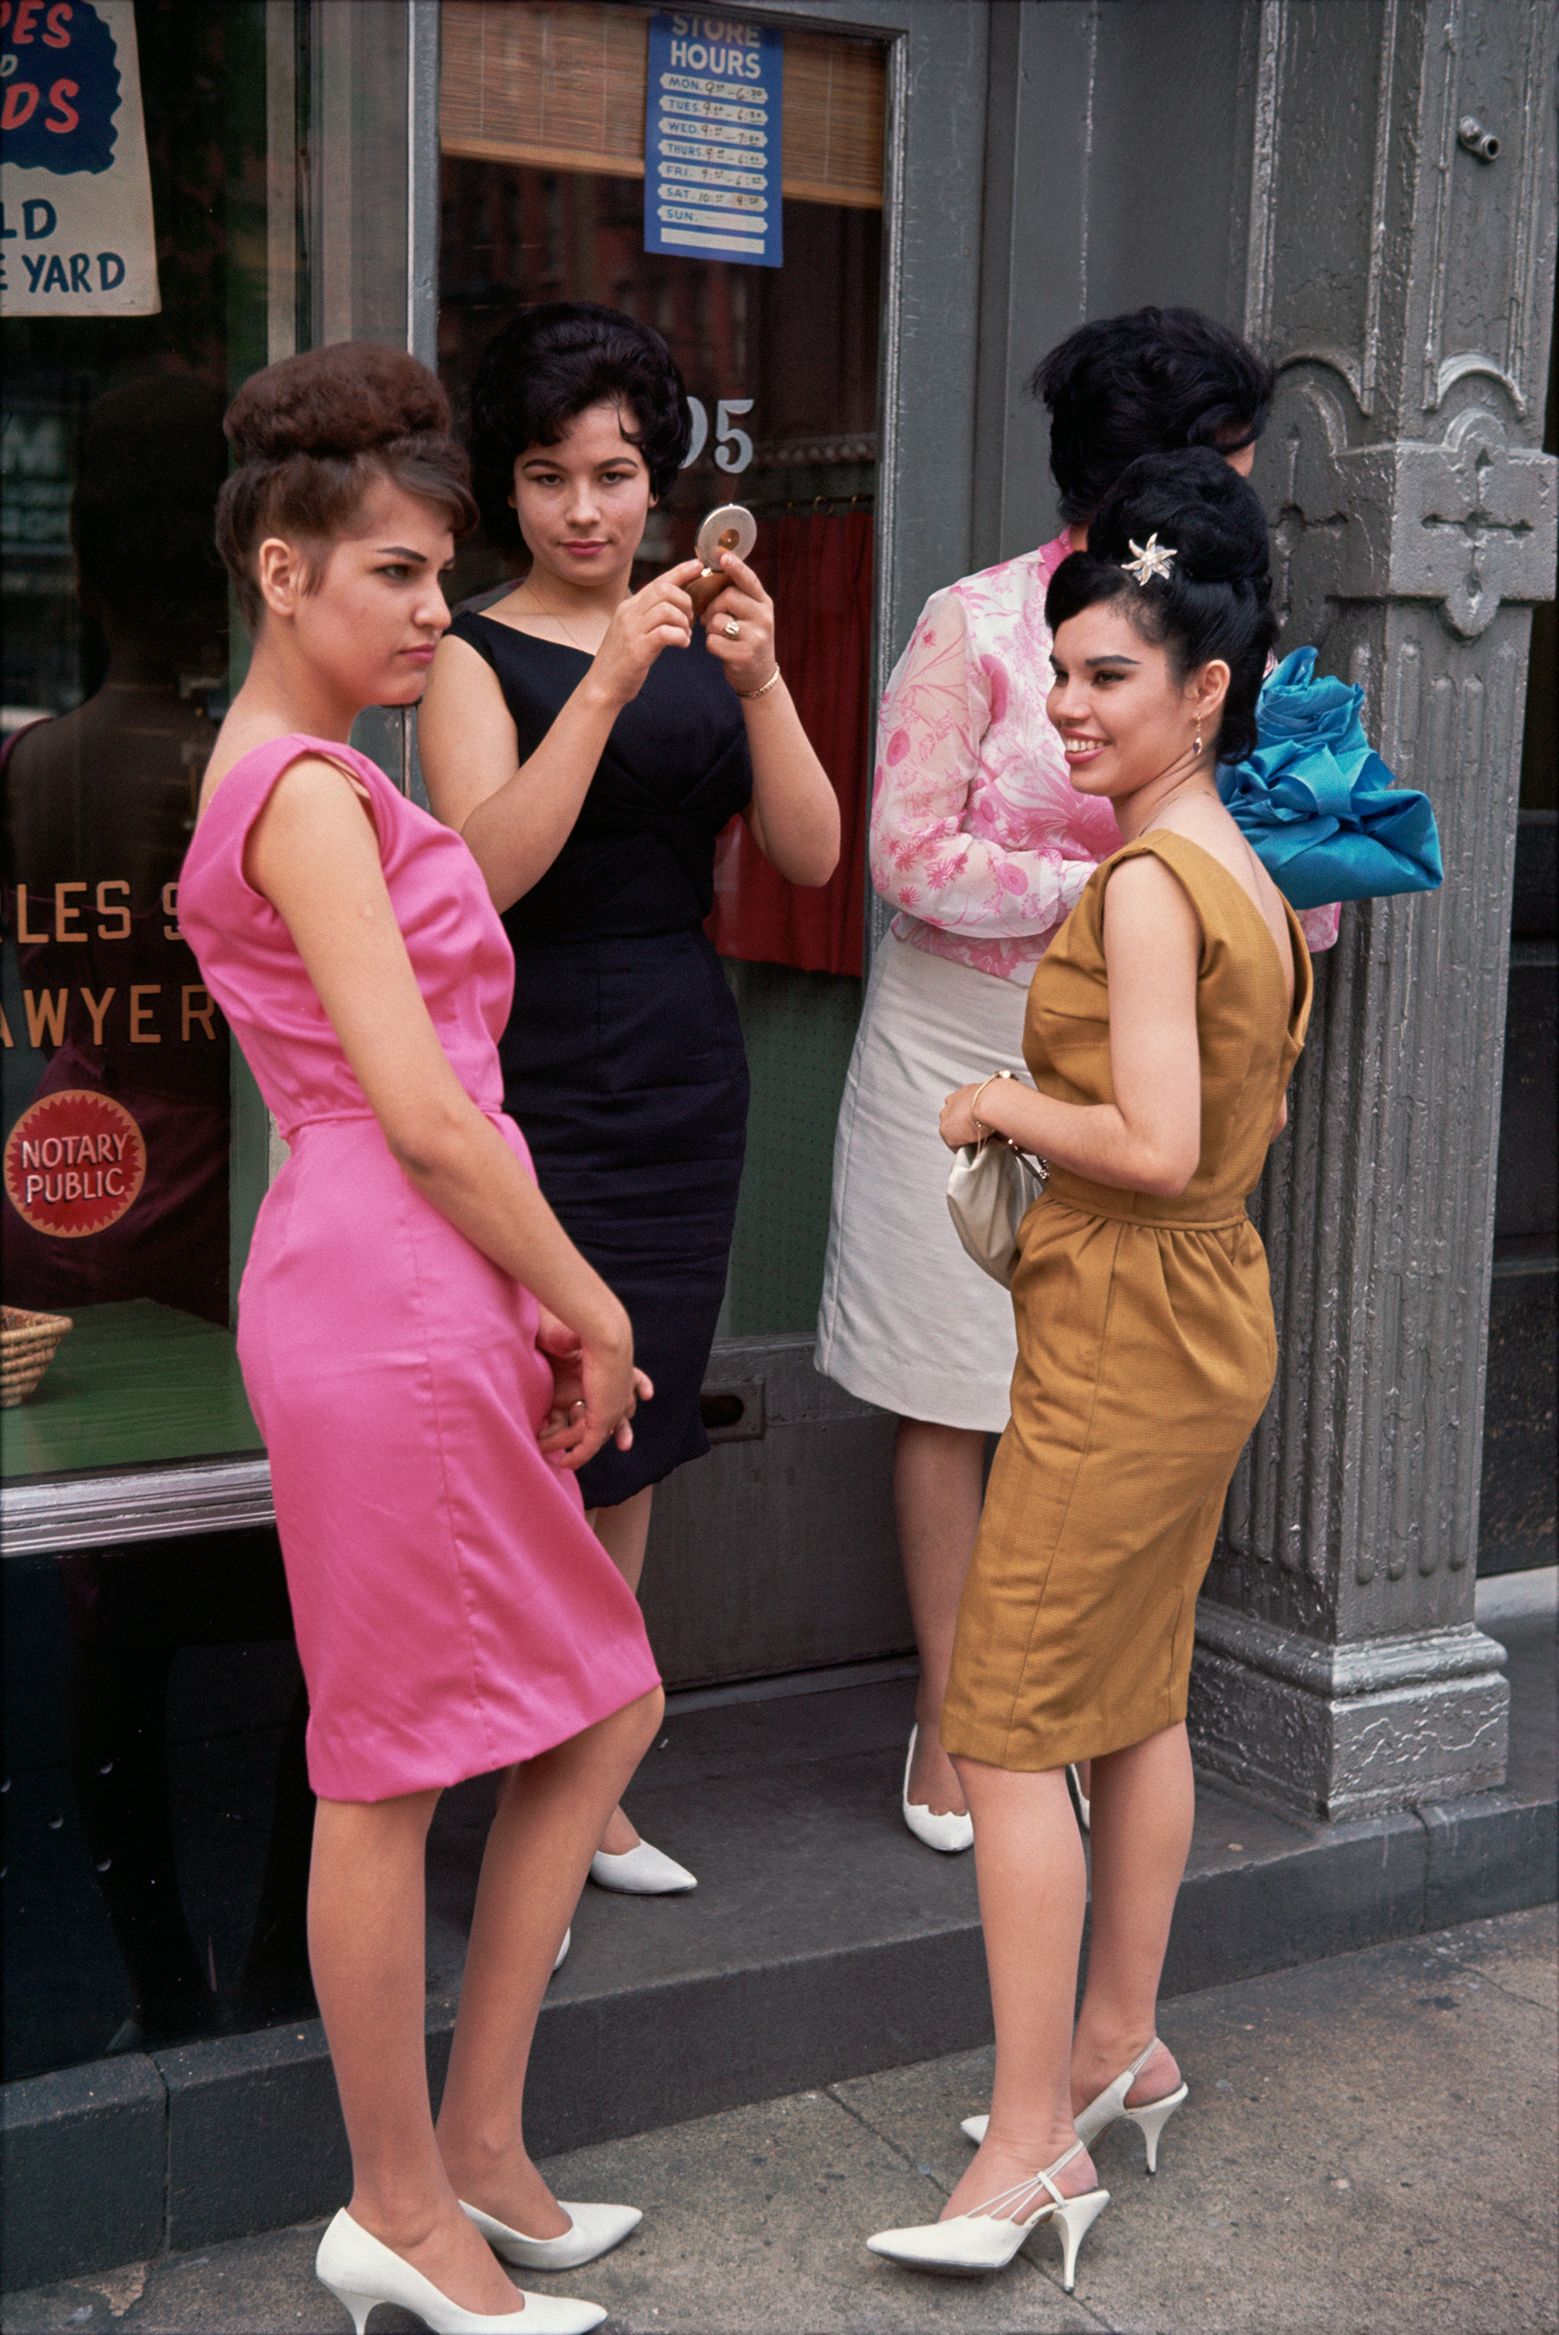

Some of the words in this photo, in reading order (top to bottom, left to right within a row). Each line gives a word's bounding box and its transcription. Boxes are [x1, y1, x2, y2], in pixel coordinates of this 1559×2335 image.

[670, 15, 761, 48] STORE
[670, 40, 761, 79] HOURS
[1, 79, 79, 133] DS
[0, 199, 57, 240] LD
[22, 252, 125, 293] YARD
[22, 1133, 128, 1169] NOTARY
[26, 1168, 125, 1203] PUBLIC
